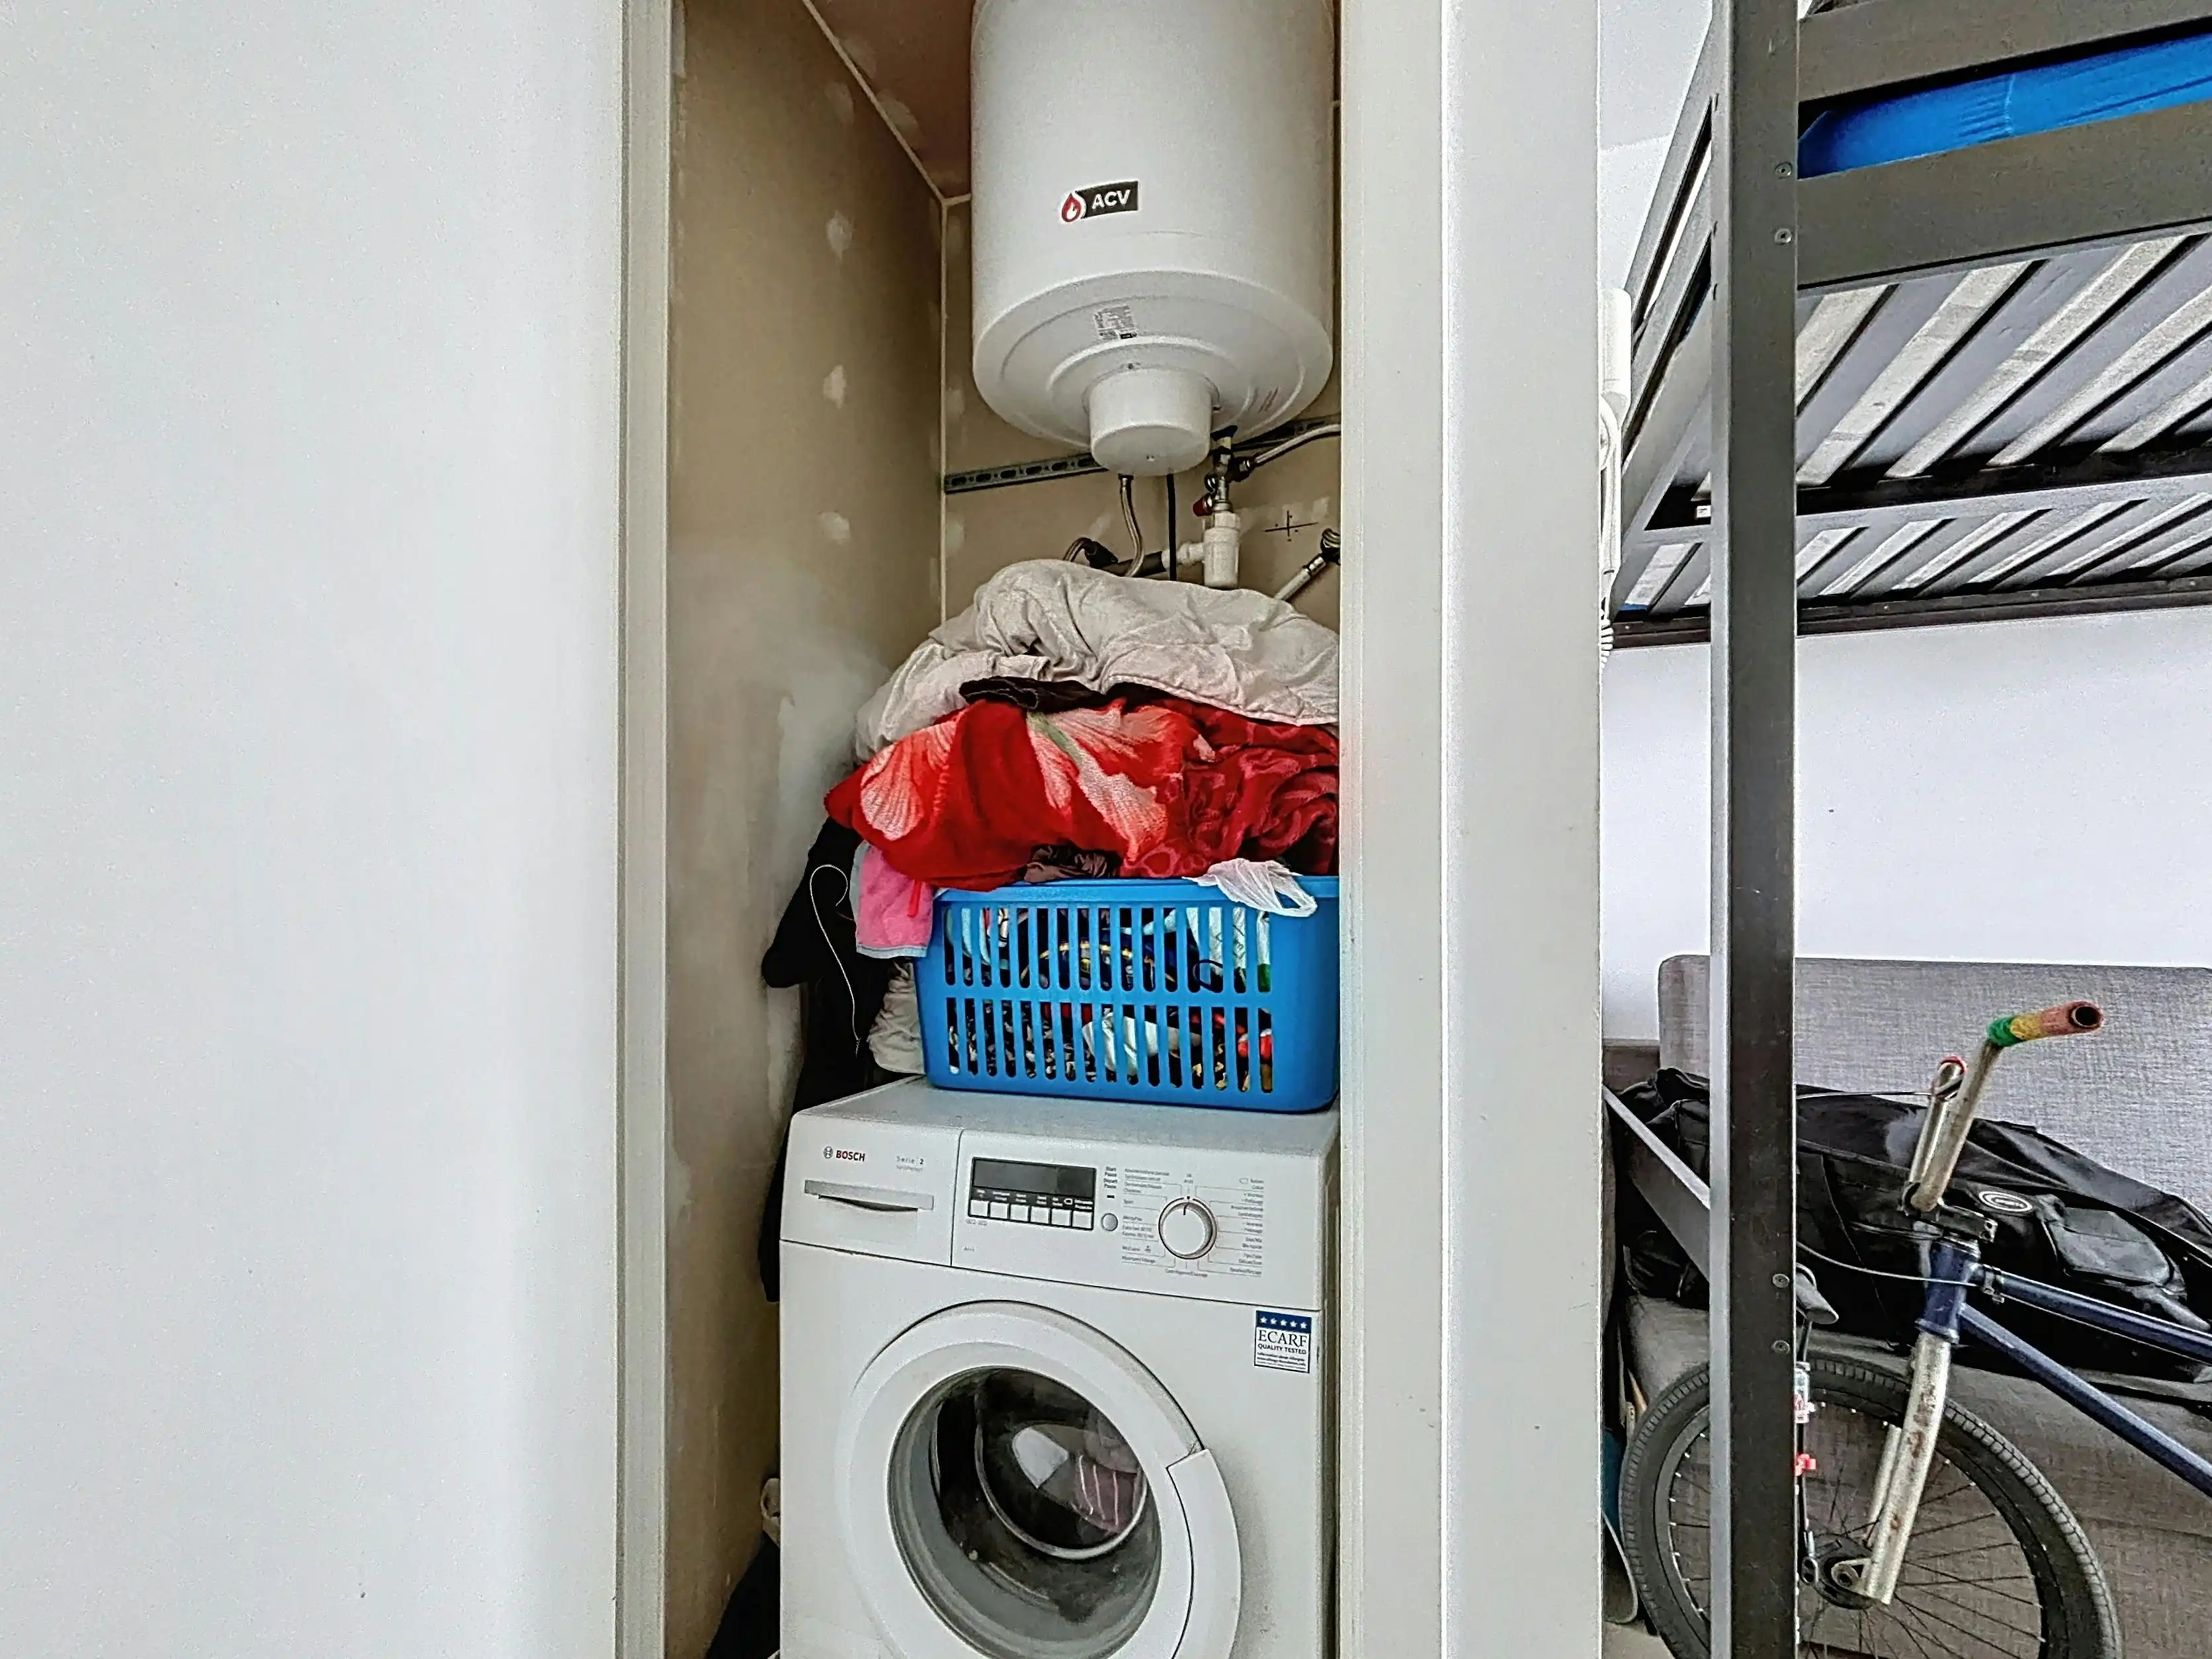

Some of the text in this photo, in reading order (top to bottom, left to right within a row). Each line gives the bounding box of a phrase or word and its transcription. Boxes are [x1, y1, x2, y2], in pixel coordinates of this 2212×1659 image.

[1091, 189, 1130, 210] ACV
[835, 1150, 866, 1162] BOSCH
[896, 1156, 915, 1164] Serie
[1258, 1329, 1307, 1347] ECARF
[1257, 1343, 1283, 1351] QUALITY
